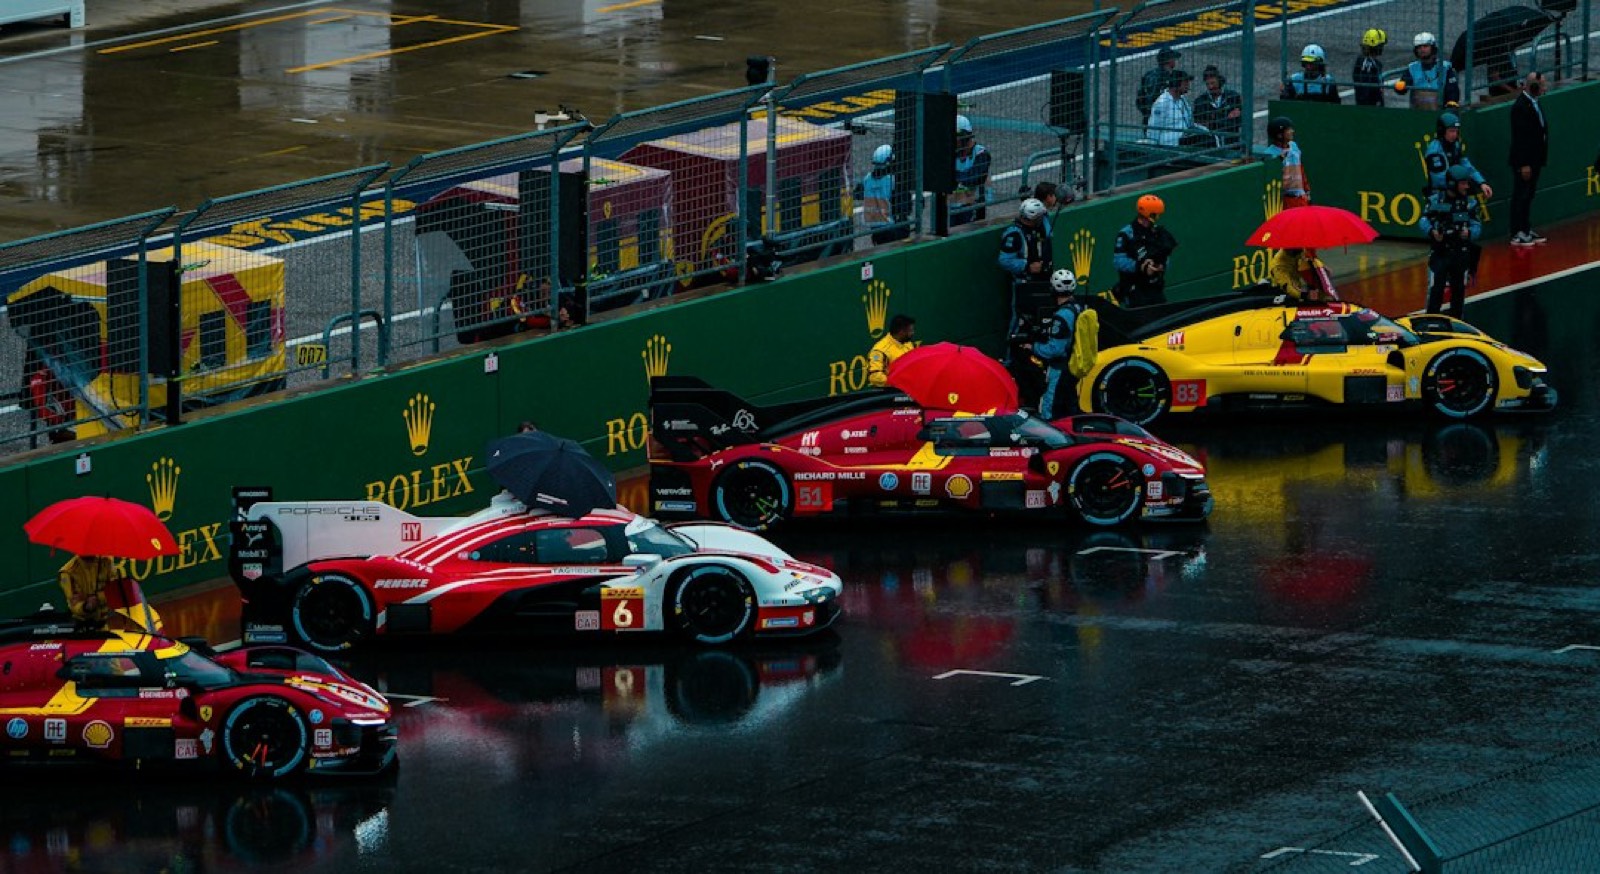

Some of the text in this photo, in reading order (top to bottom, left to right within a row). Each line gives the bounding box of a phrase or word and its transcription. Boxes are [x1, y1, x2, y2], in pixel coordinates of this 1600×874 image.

[1168, 332, 1184, 345] HY
[1176, 383, 1199, 402] 83
[801, 431, 820, 446] HY
[365, 456, 475, 510] ROLEX
[794, 472, 866, 480] RICHARD MILLE
[799, 487, 823, 505] 51
[402, 524, 420, 541] HY
[373, 579, 430, 588] PENSKE
[613, 600, 633, 627] 6
